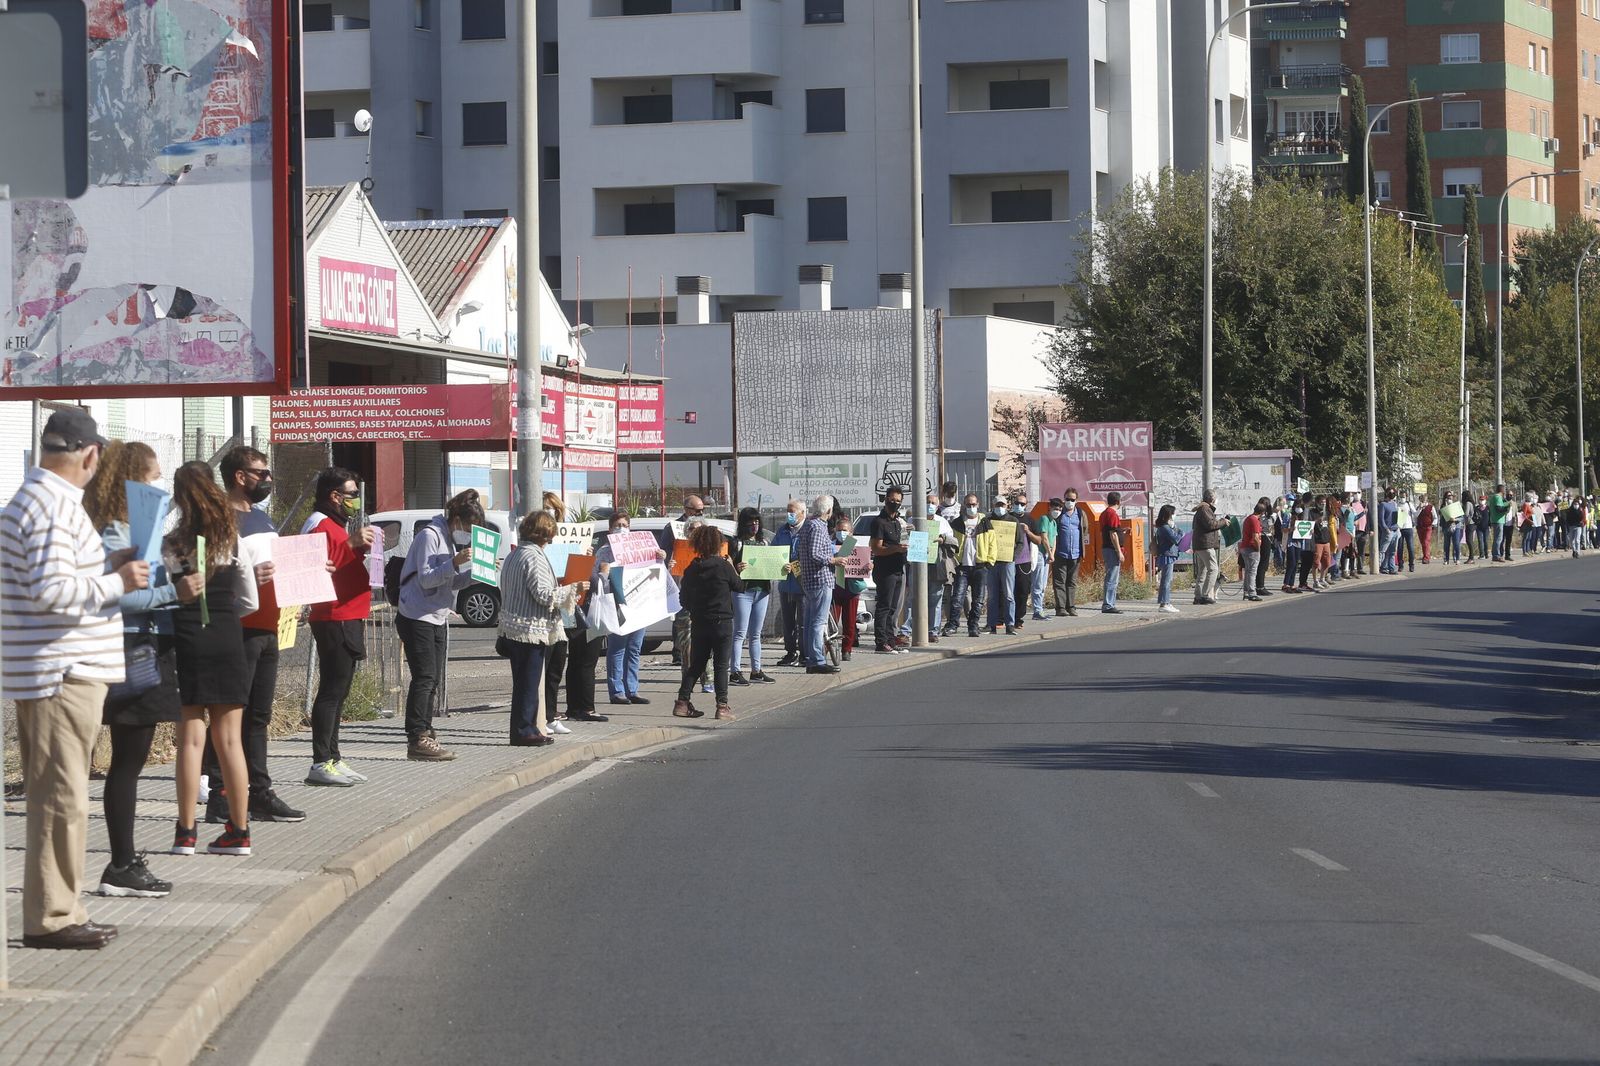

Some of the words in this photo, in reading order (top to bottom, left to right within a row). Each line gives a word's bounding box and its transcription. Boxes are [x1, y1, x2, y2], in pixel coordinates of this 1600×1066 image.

[322, 268, 366, 324] ALMACENES
[367, 267, 395, 328] GÓMEZ
[299, 388, 330, 396] CHAISE
[331, 388, 367, 397] LONGUE,
[368, 387, 428, 396] DORMITORIOS
[272, 400, 312, 408] SALONES,
[313, 399, 352, 407] MUEBLES
[353, 398, 401, 406] AUXILIARES
[272, 411, 298, 419] MESA,
[299, 410, 329, 418] SILLAS,
[330, 410, 364, 418] BUTACA
[365, 409, 393, 417] RELAX,
[395, 408, 445, 416] COLCHONES
[272, 421, 313, 430] CANAPES,
[314, 421, 358, 429] SOMIERES,
[359, 420, 385, 428] BASES
[386, 420, 435, 428] TAPIZADAS,
[437, 418, 491, 427] ALMOHADAS
[274, 433, 308, 441] FUNDAS
[309, 431, 355, 441] NÓRDICAS,
[356, 431, 407, 439] CABECEROS,
[408, 430, 431, 438] ETC...
[1043, 427, 1149, 448] PARKING
[1067, 450, 1125, 462] CLIENTES
[784, 467, 842, 476] ENTRADA
[789, 479, 822, 487] LAVADO
[571, 527, 577, 537] A
[581, 527, 591, 537] LA
[609, 534, 621, 544] LA
[621, 531, 654, 542] SANIDAD
